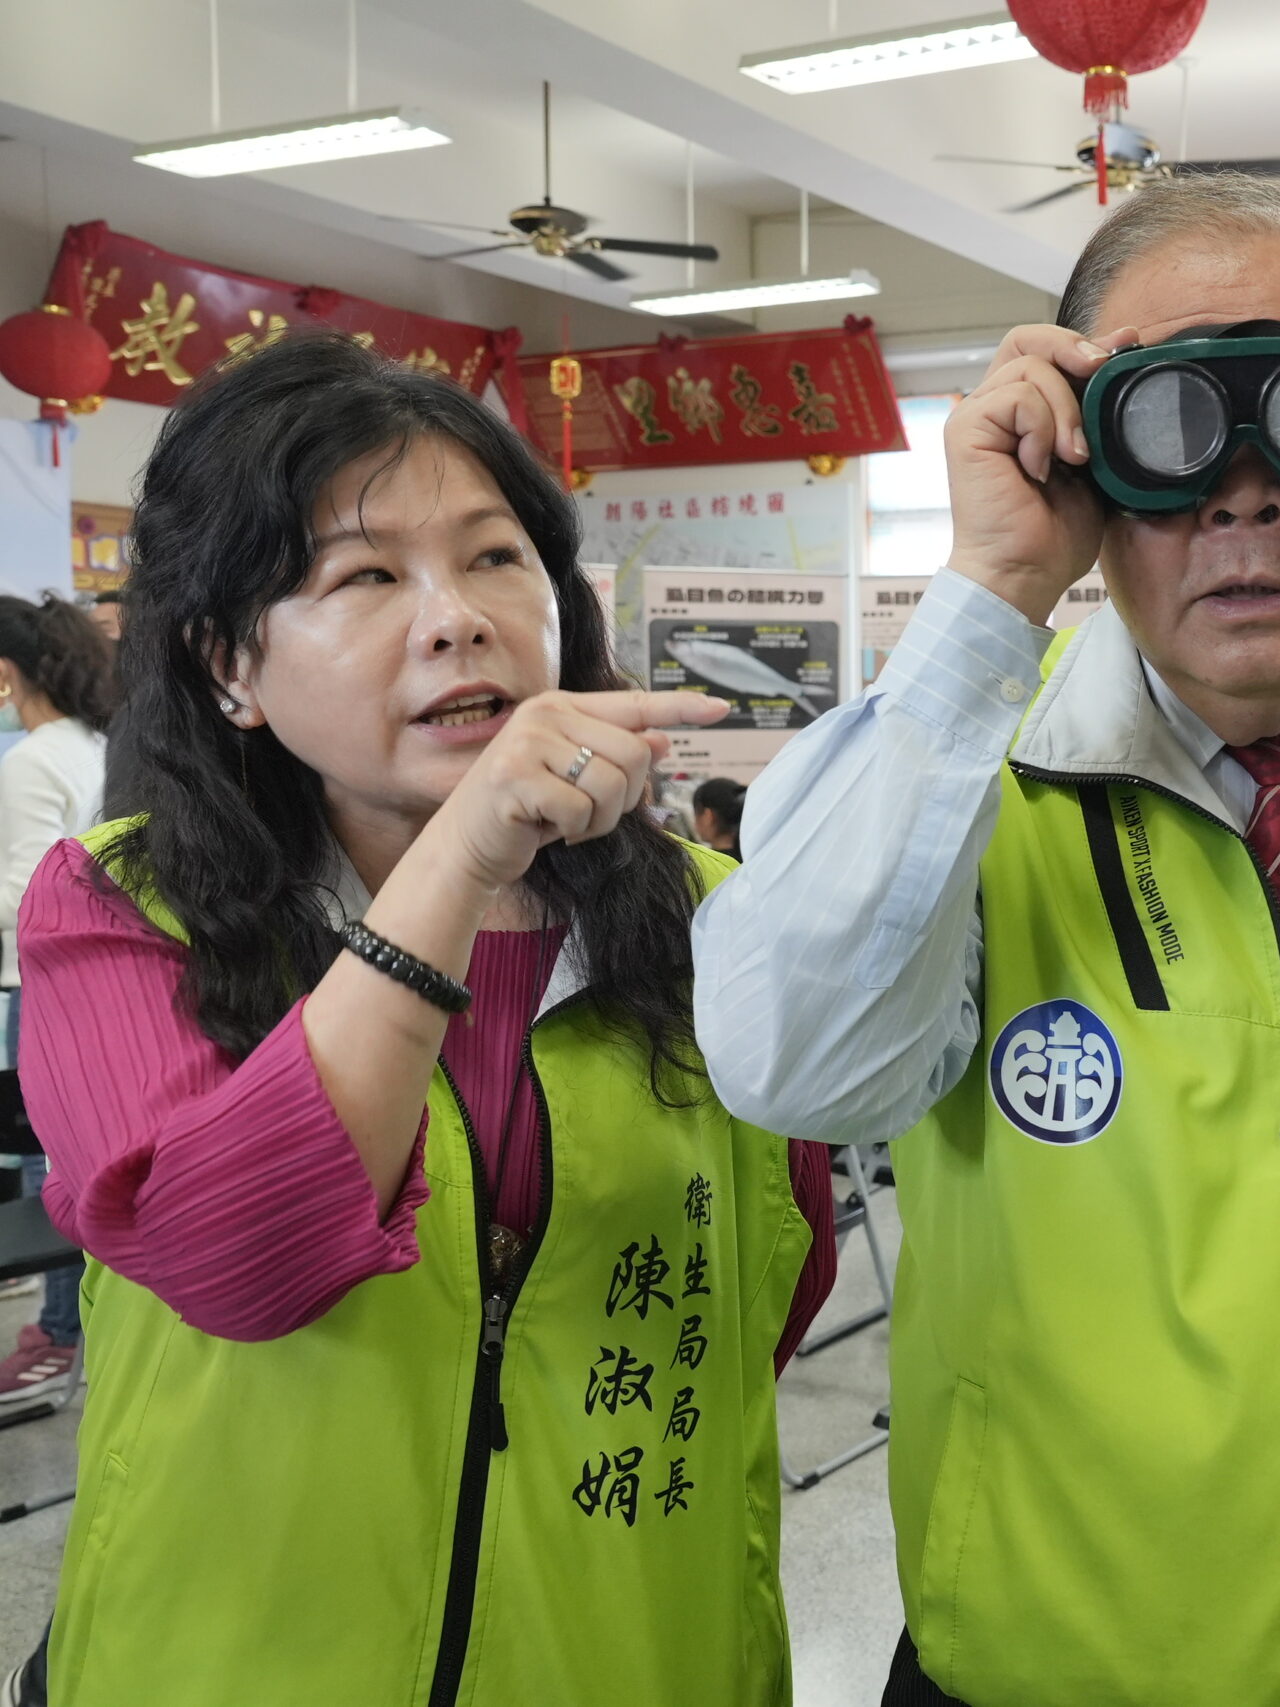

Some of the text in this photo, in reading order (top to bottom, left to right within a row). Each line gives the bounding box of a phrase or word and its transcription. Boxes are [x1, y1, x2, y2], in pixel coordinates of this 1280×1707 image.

[1128, 825, 1151, 857] SPORT
[1156, 922, 1185, 966] MODE
[571, 1233, 675, 1528] 陳淑娟
[653, 1172, 713, 1518] 衛生局局長
